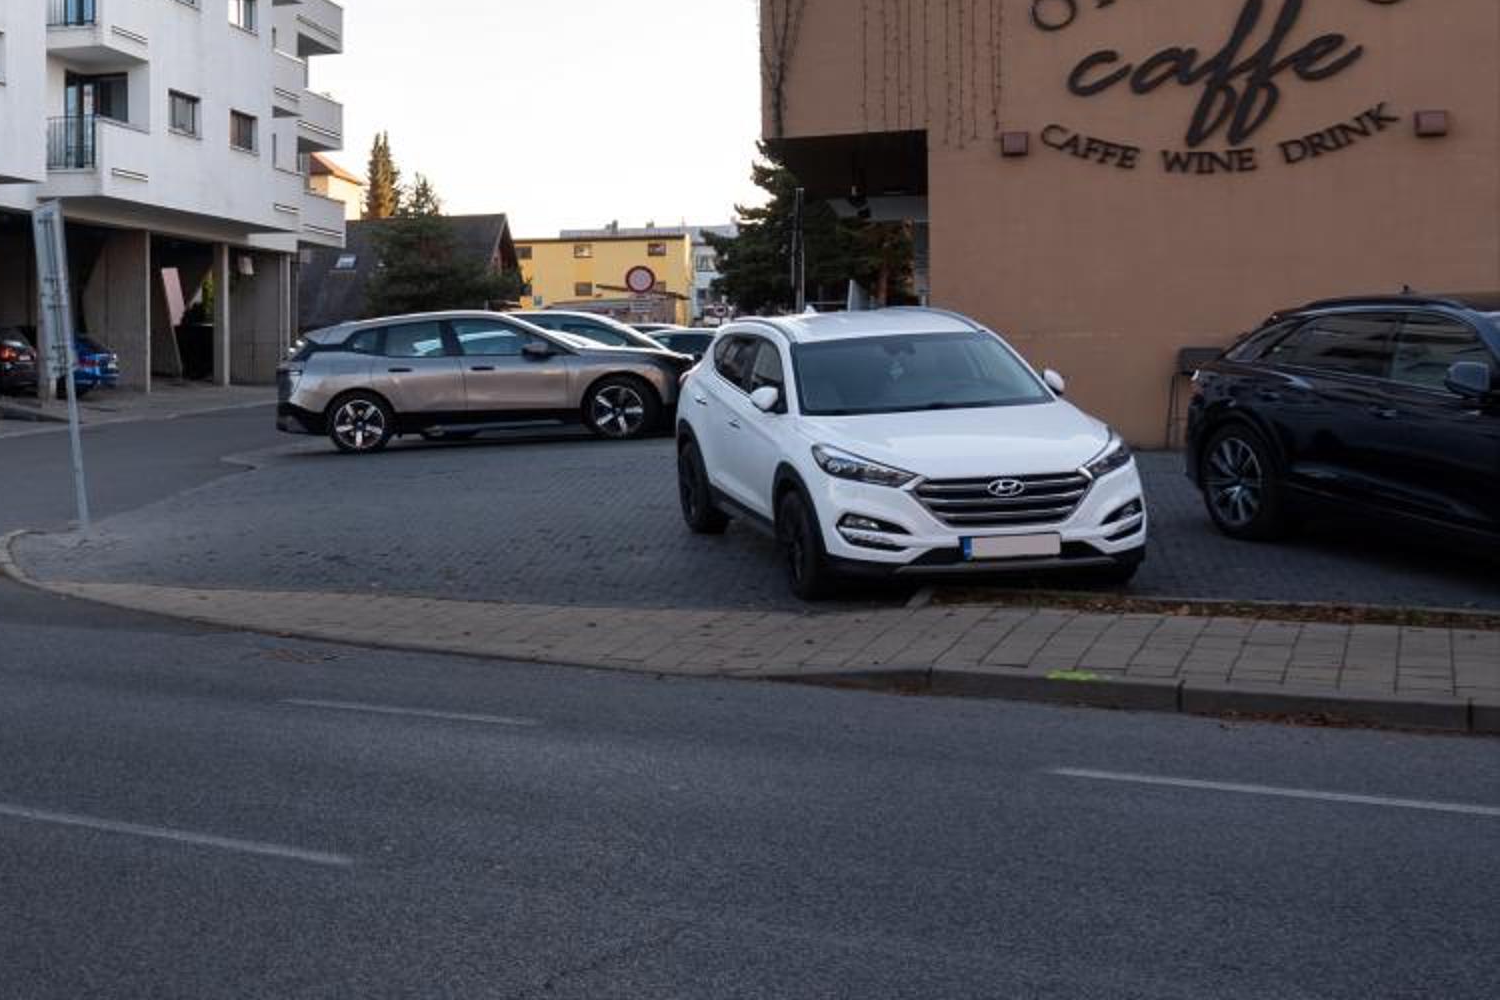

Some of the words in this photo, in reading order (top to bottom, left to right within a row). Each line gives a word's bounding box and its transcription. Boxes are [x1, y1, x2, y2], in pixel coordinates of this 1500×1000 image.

[1041, 124, 1140, 170] CAFFE
[1161, 149, 1258, 174] WINE
[1279, 102, 1400, 164] DRINK
